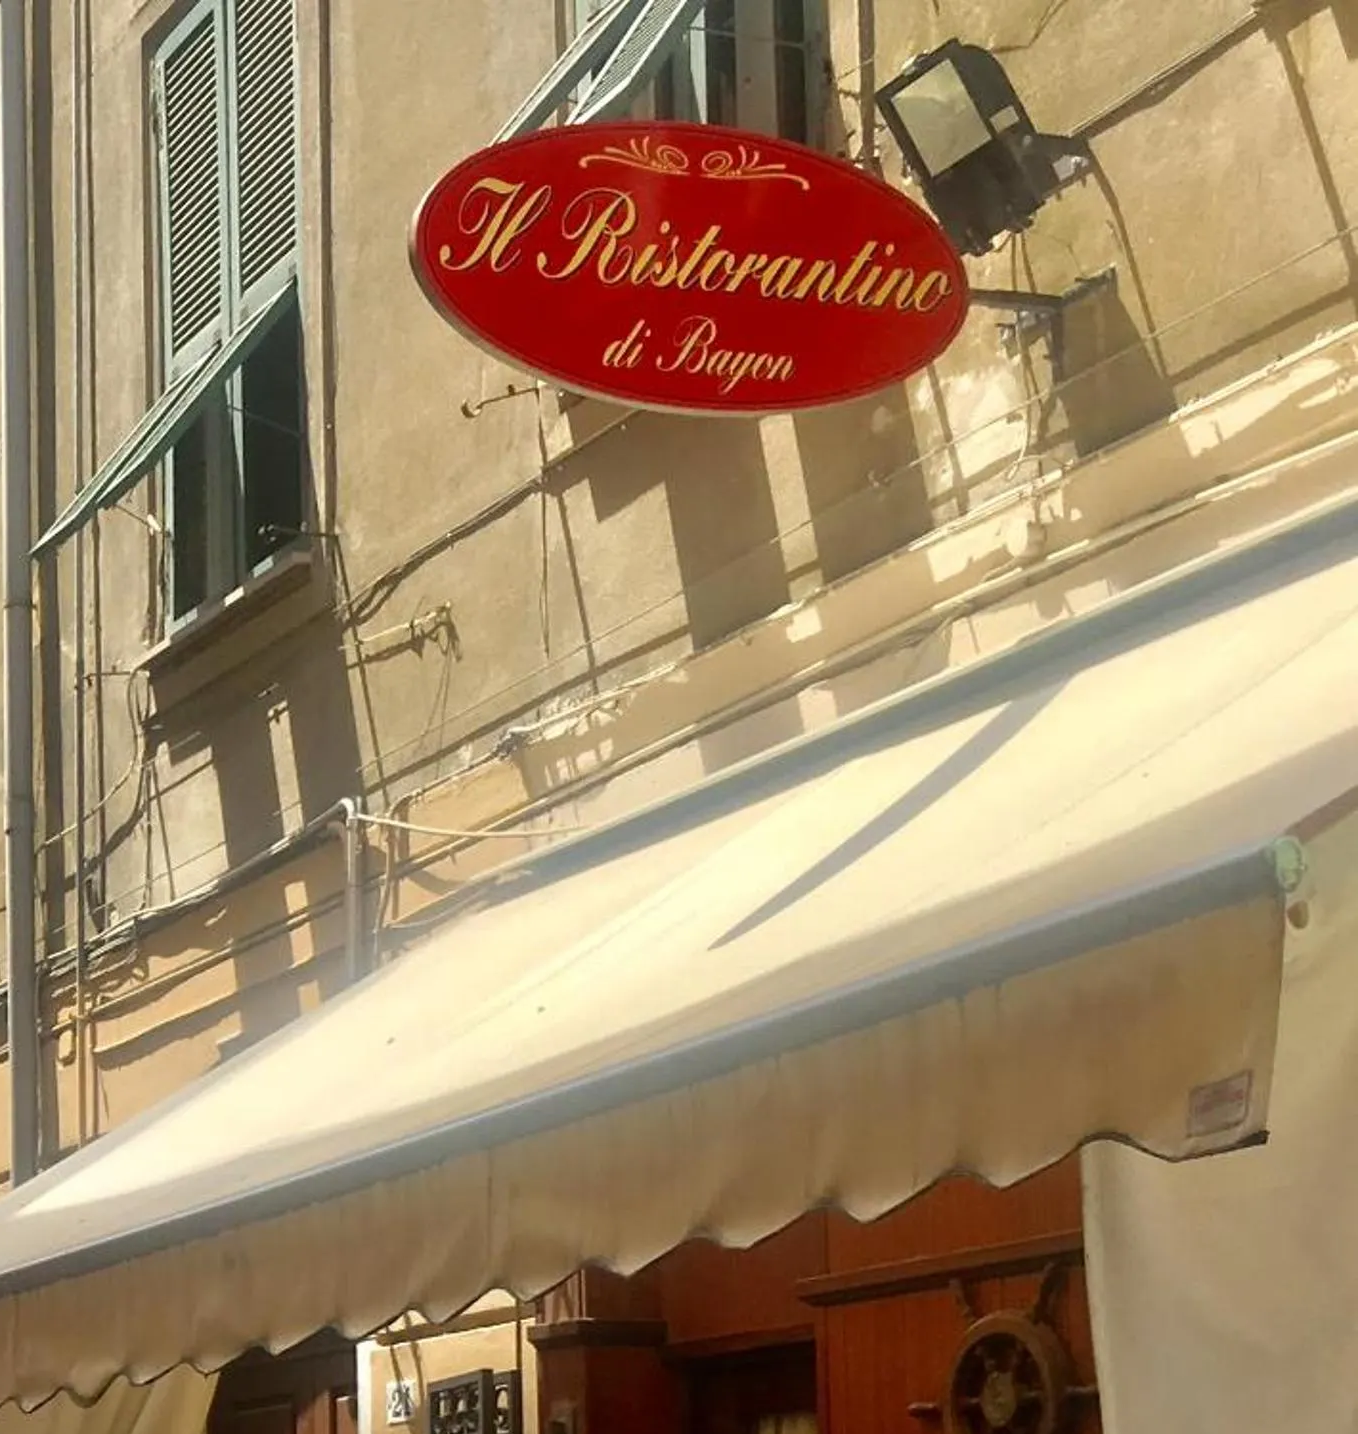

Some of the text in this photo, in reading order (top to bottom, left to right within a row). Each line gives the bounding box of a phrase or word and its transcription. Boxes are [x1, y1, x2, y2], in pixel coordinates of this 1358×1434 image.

[438, 177, 953, 312] Il Ristorantino
[602, 315, 794, 396] di Bayon
